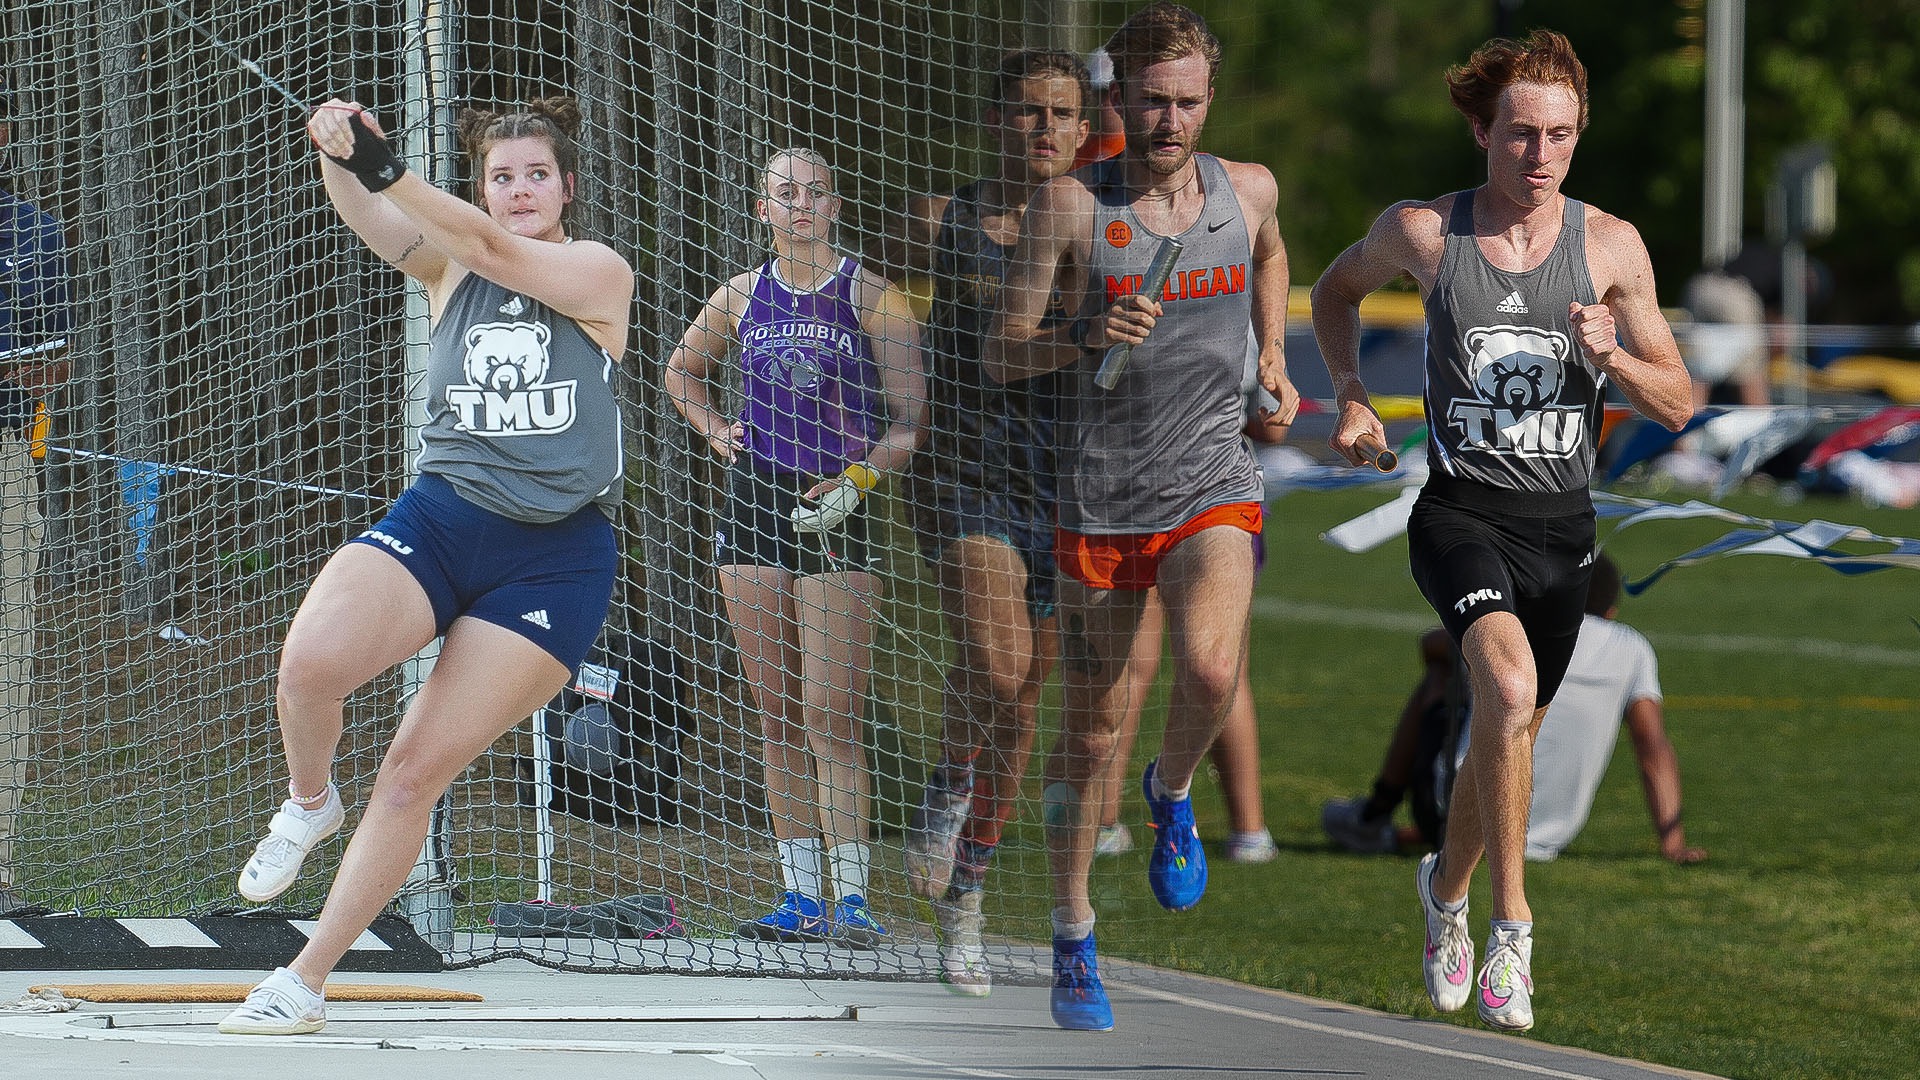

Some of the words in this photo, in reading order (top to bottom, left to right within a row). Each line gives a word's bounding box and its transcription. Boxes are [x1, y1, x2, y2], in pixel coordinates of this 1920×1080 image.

[1111, 228, 1127, 241] EC
[1105, 263, 1246, 303] MLIGAN
[1496, 304, 1529, 314] adidas
[449, 386, 571, 431] TMU
[1453, 404, 1583, 452] TMU
[1454, 588, 1503, 615] TMU
